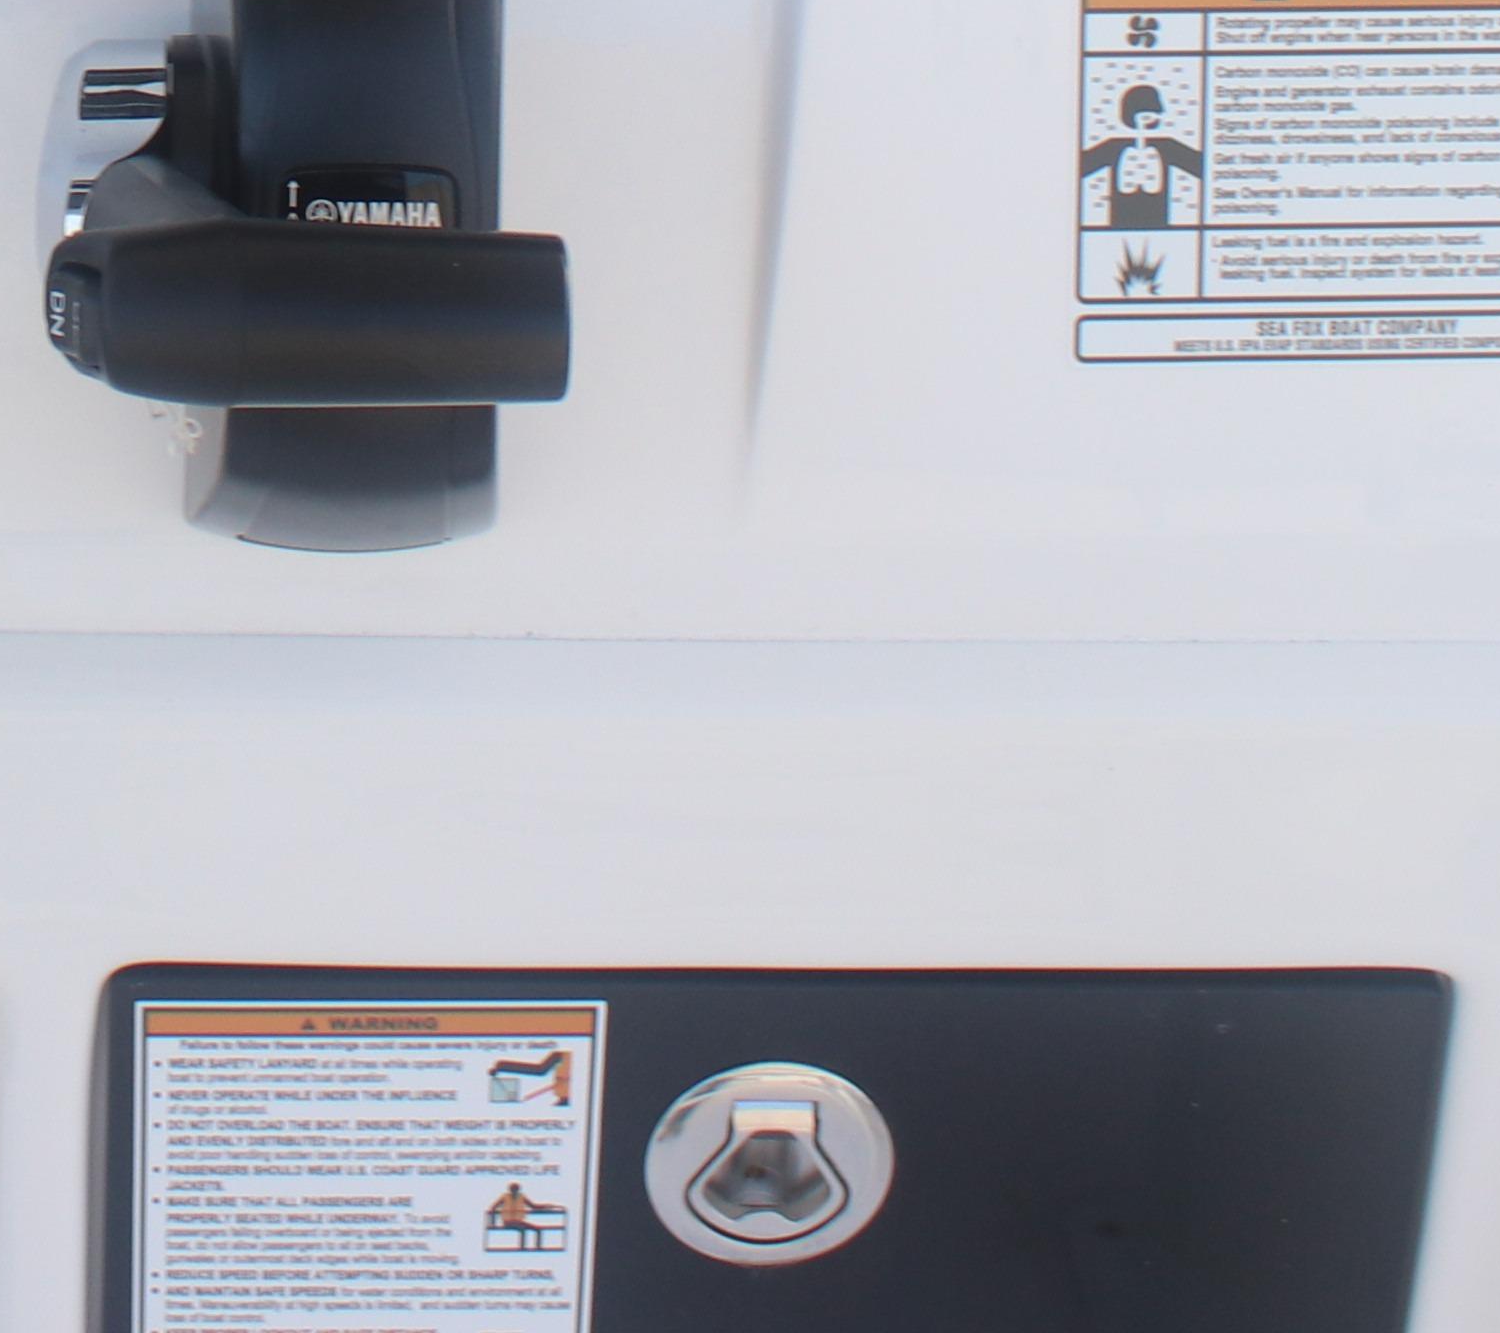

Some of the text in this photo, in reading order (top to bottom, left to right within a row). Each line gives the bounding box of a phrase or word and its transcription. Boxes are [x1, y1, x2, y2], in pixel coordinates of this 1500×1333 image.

[337, 201, 442, 228] YAMAHA
[1256, 320, 1457, 335] SEA FOX BOAT COMPANY
[330, 1016, 438, 1031] WARNING
